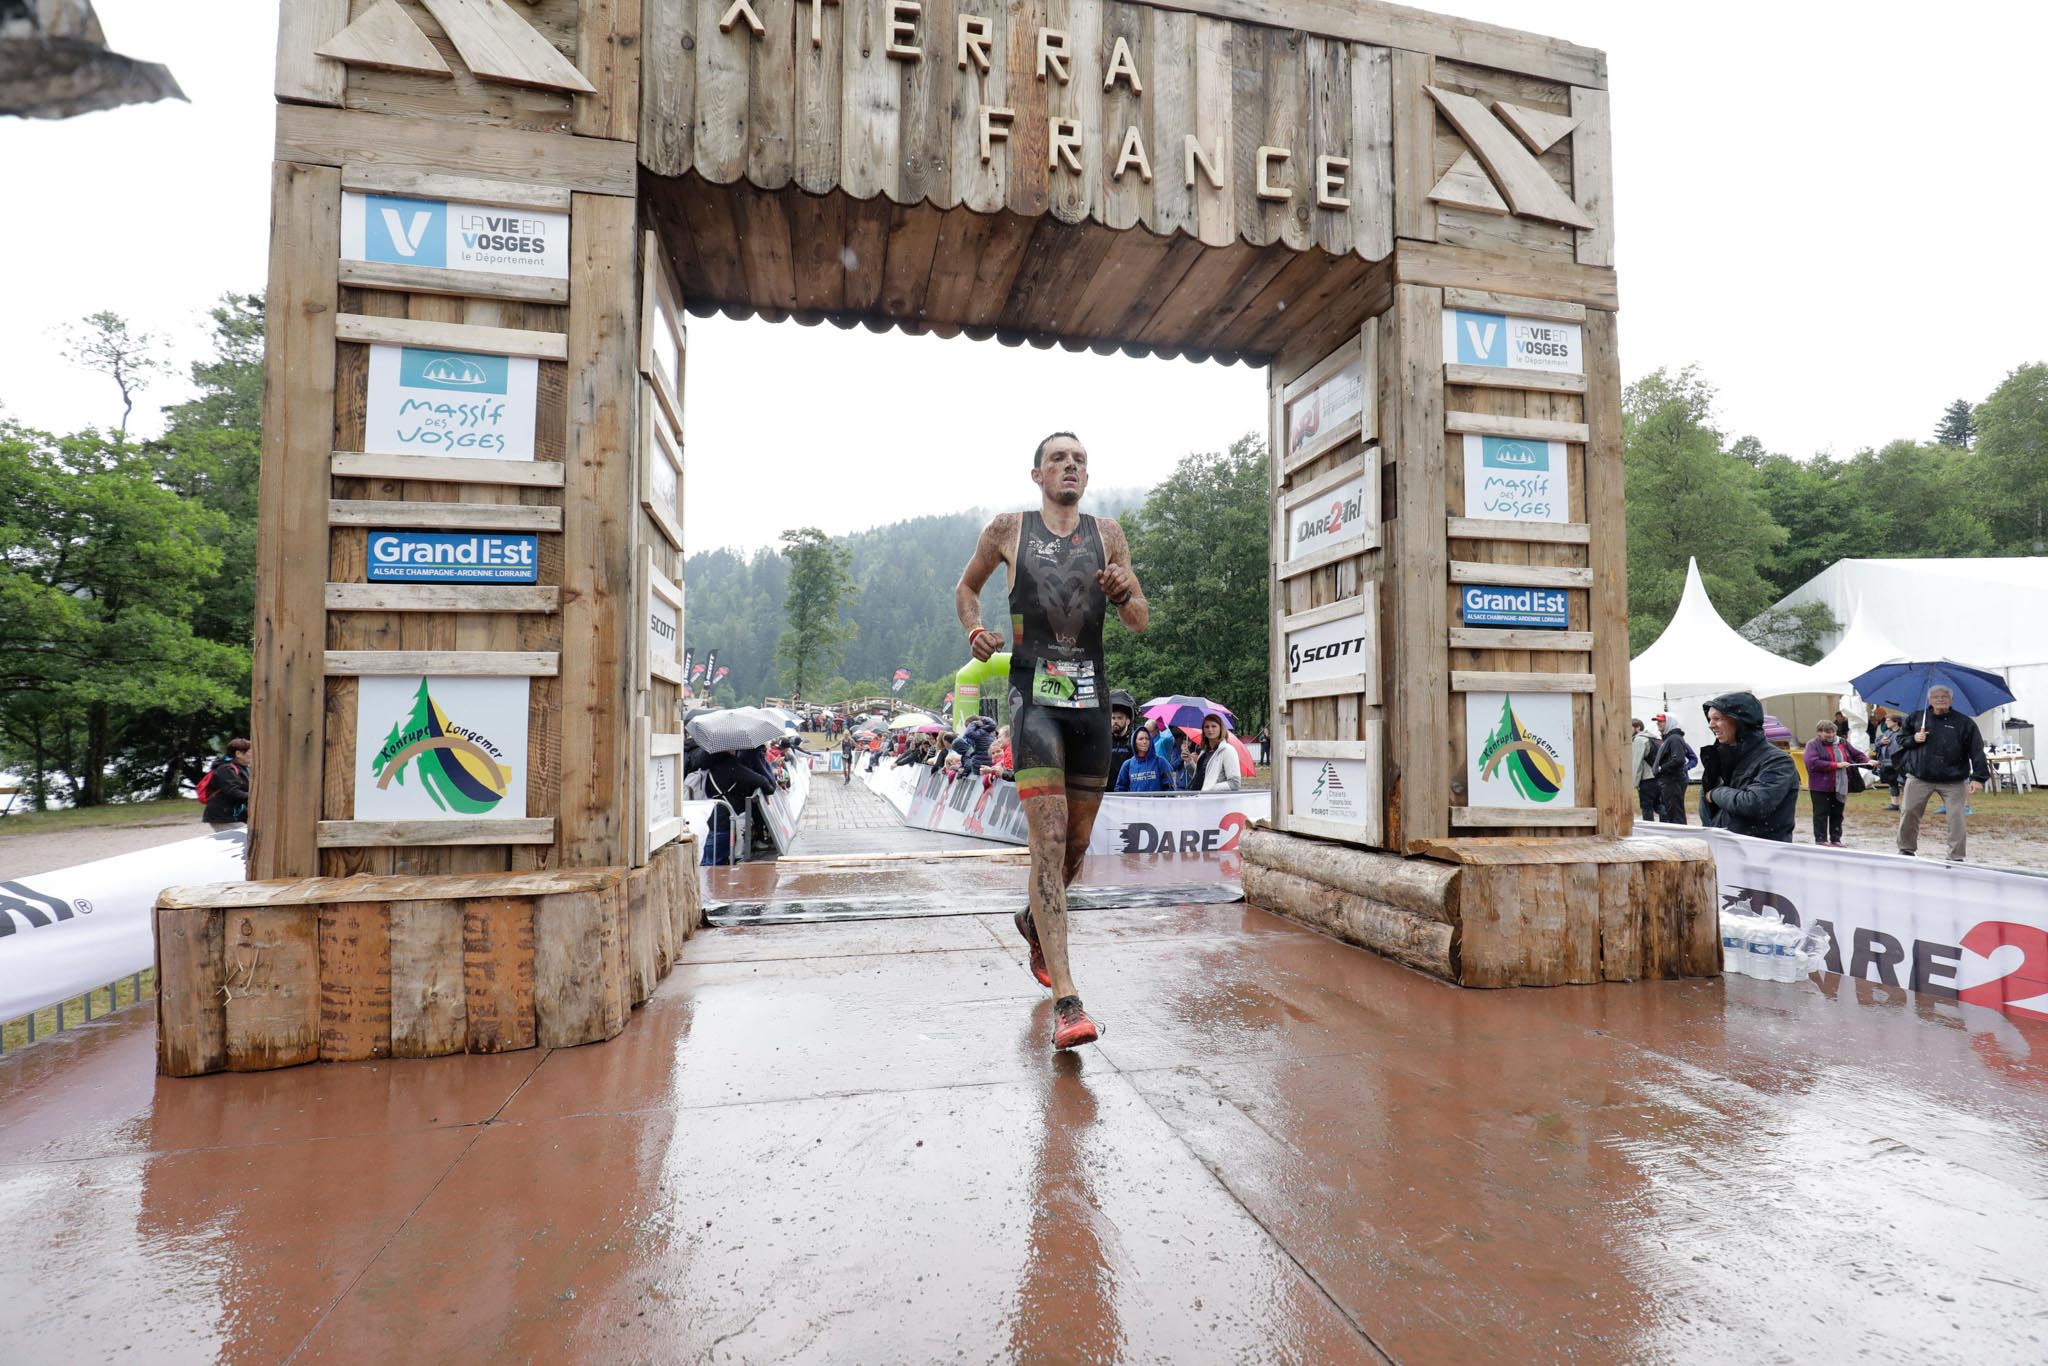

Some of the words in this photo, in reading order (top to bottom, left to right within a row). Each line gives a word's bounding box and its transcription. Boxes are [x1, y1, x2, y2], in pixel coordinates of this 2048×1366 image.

[979, 103, 1352, 209] FRANCE
[461, 215, 484, 231] LA
[486, 216, 520, 234] VIE
[462, 232, 545, 254] VOSGES
[461, 251, 472, 261] le
[475, 251, 545, 266] Département
[1530, 327, 1552, 341] VIE
[1516, 339, 1569, 357] VOSGES
[1524, 356, 1569, 368] Département
[425, 418, 448, 429] DES
[396, 426, 505, 453] VOSGES
[1483, 497, 1552, 519] VOSGES
[373, 567, 405, 576] ALSACE
[405, 568, 494, 577] CHAMPAGNE-ARDENNE
[494, 569, 532, 578] LORRAINE
[1486, 614, 1541, 622] CHAMPAGNE-ARDENNE
[651, 613, 676, 643] SCOTT
[1302, 637, 1366, 664] SCOTT
[1040, 680, 1062, 696] 270
[445, 721, 503, 760] Longemer
[1522, 728, 1560, 759] Longemer
